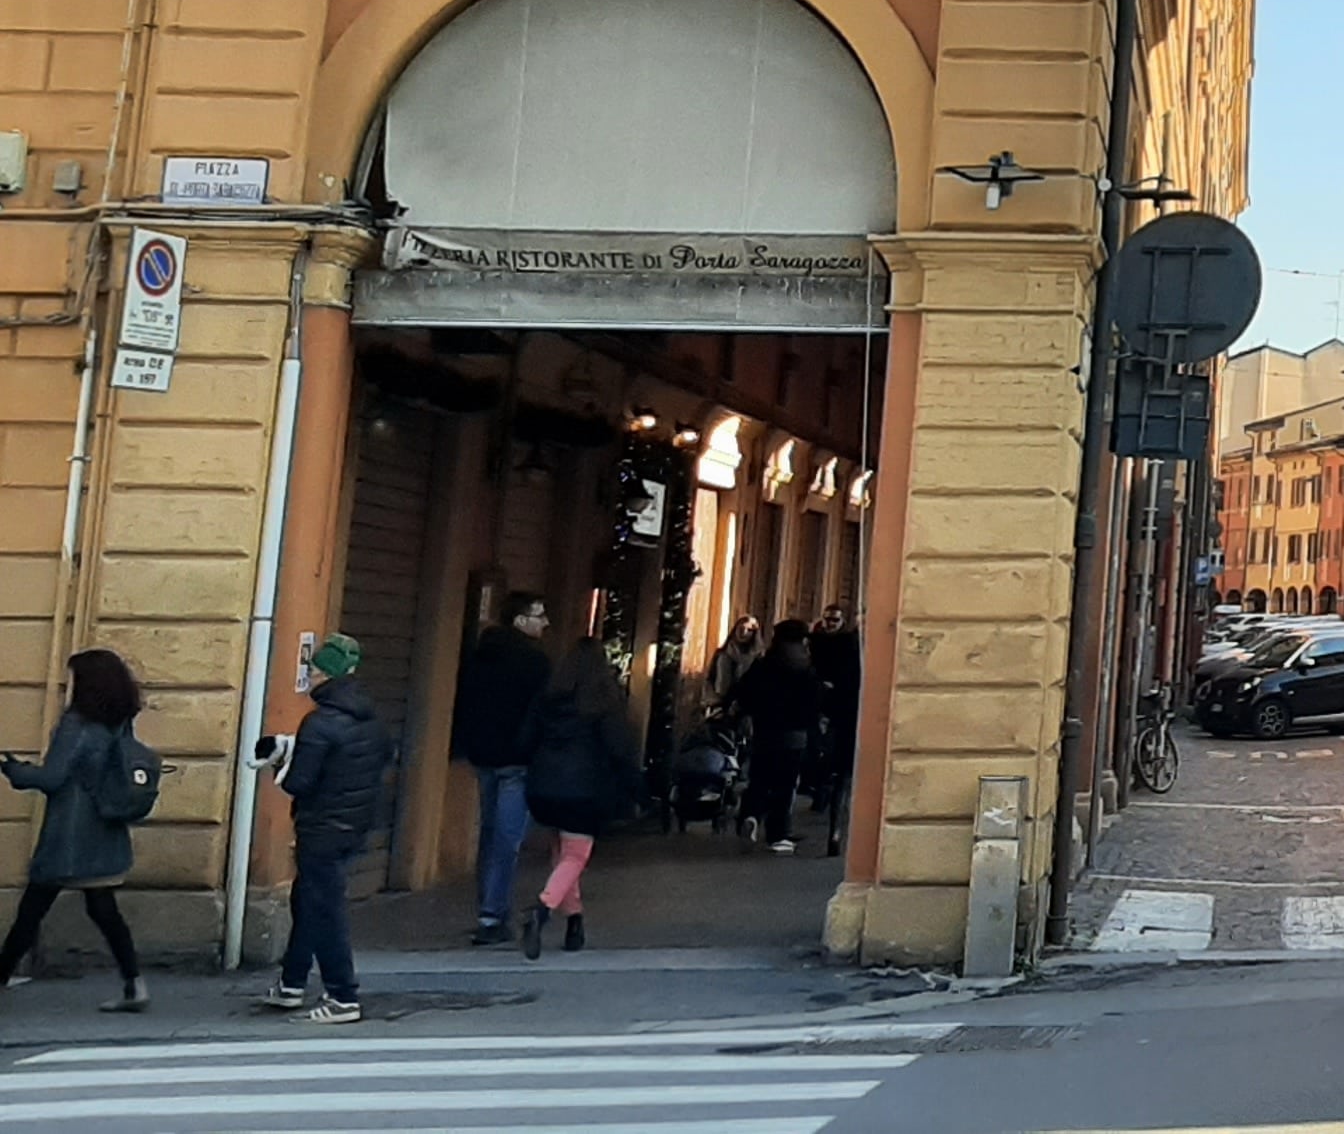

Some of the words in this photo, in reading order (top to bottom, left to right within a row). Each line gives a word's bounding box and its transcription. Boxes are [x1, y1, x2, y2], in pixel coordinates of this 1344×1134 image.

[195, 162, 239, 176] PIAZZA
[497, 250, 633, 268] RISTORANTE
[643, 255, 661, 267] DI
[669, 245, 738, 268] Porta
[750, 245, 862, 275] Saragozza
